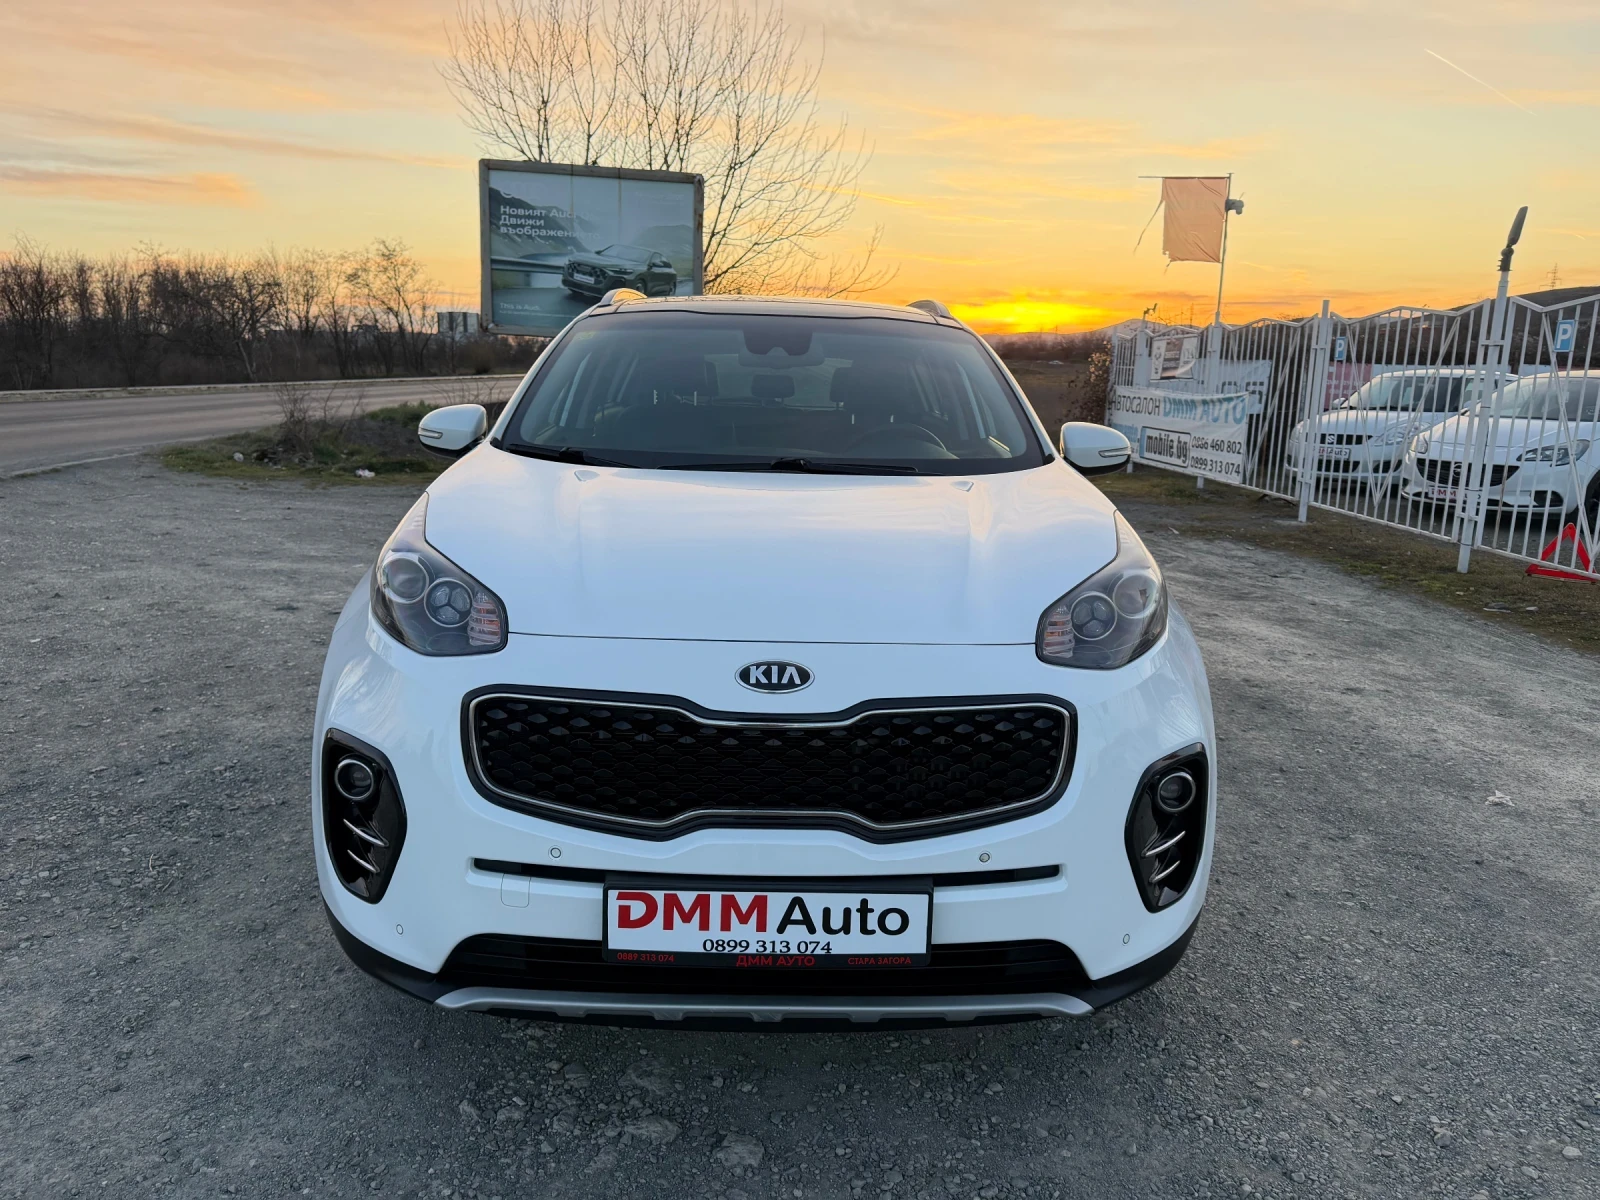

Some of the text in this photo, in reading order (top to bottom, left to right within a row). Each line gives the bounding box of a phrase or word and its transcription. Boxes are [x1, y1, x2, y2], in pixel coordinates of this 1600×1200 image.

[500, 205, 546, 217] Новият
[500, 215, 544, 226] Движи
[1557, 324, 1572, 348] P
[1335, 341, 1344, 358] P
[1163, 396, 1197, 420] DMM
[1200, 396, 1246, 424] AUTO
[1209, 438, 1225, 452] 460
[1226, 440, 1242, 454] 802
[1208, 459, 1223, 473] 313
[1224, 462, 1241, 476] 074
[749, 665, 802, 685] KIA
[615, 891, 910, 936] DMM Auto
[702, 938, 833, 954] 0899 313 074
[617, 952, 675, 962] 0889 313 074
[736, 955, 816, 967] ДММ АУТО
[847, 956, 912, 965] СТАРА ЗАГОРА
